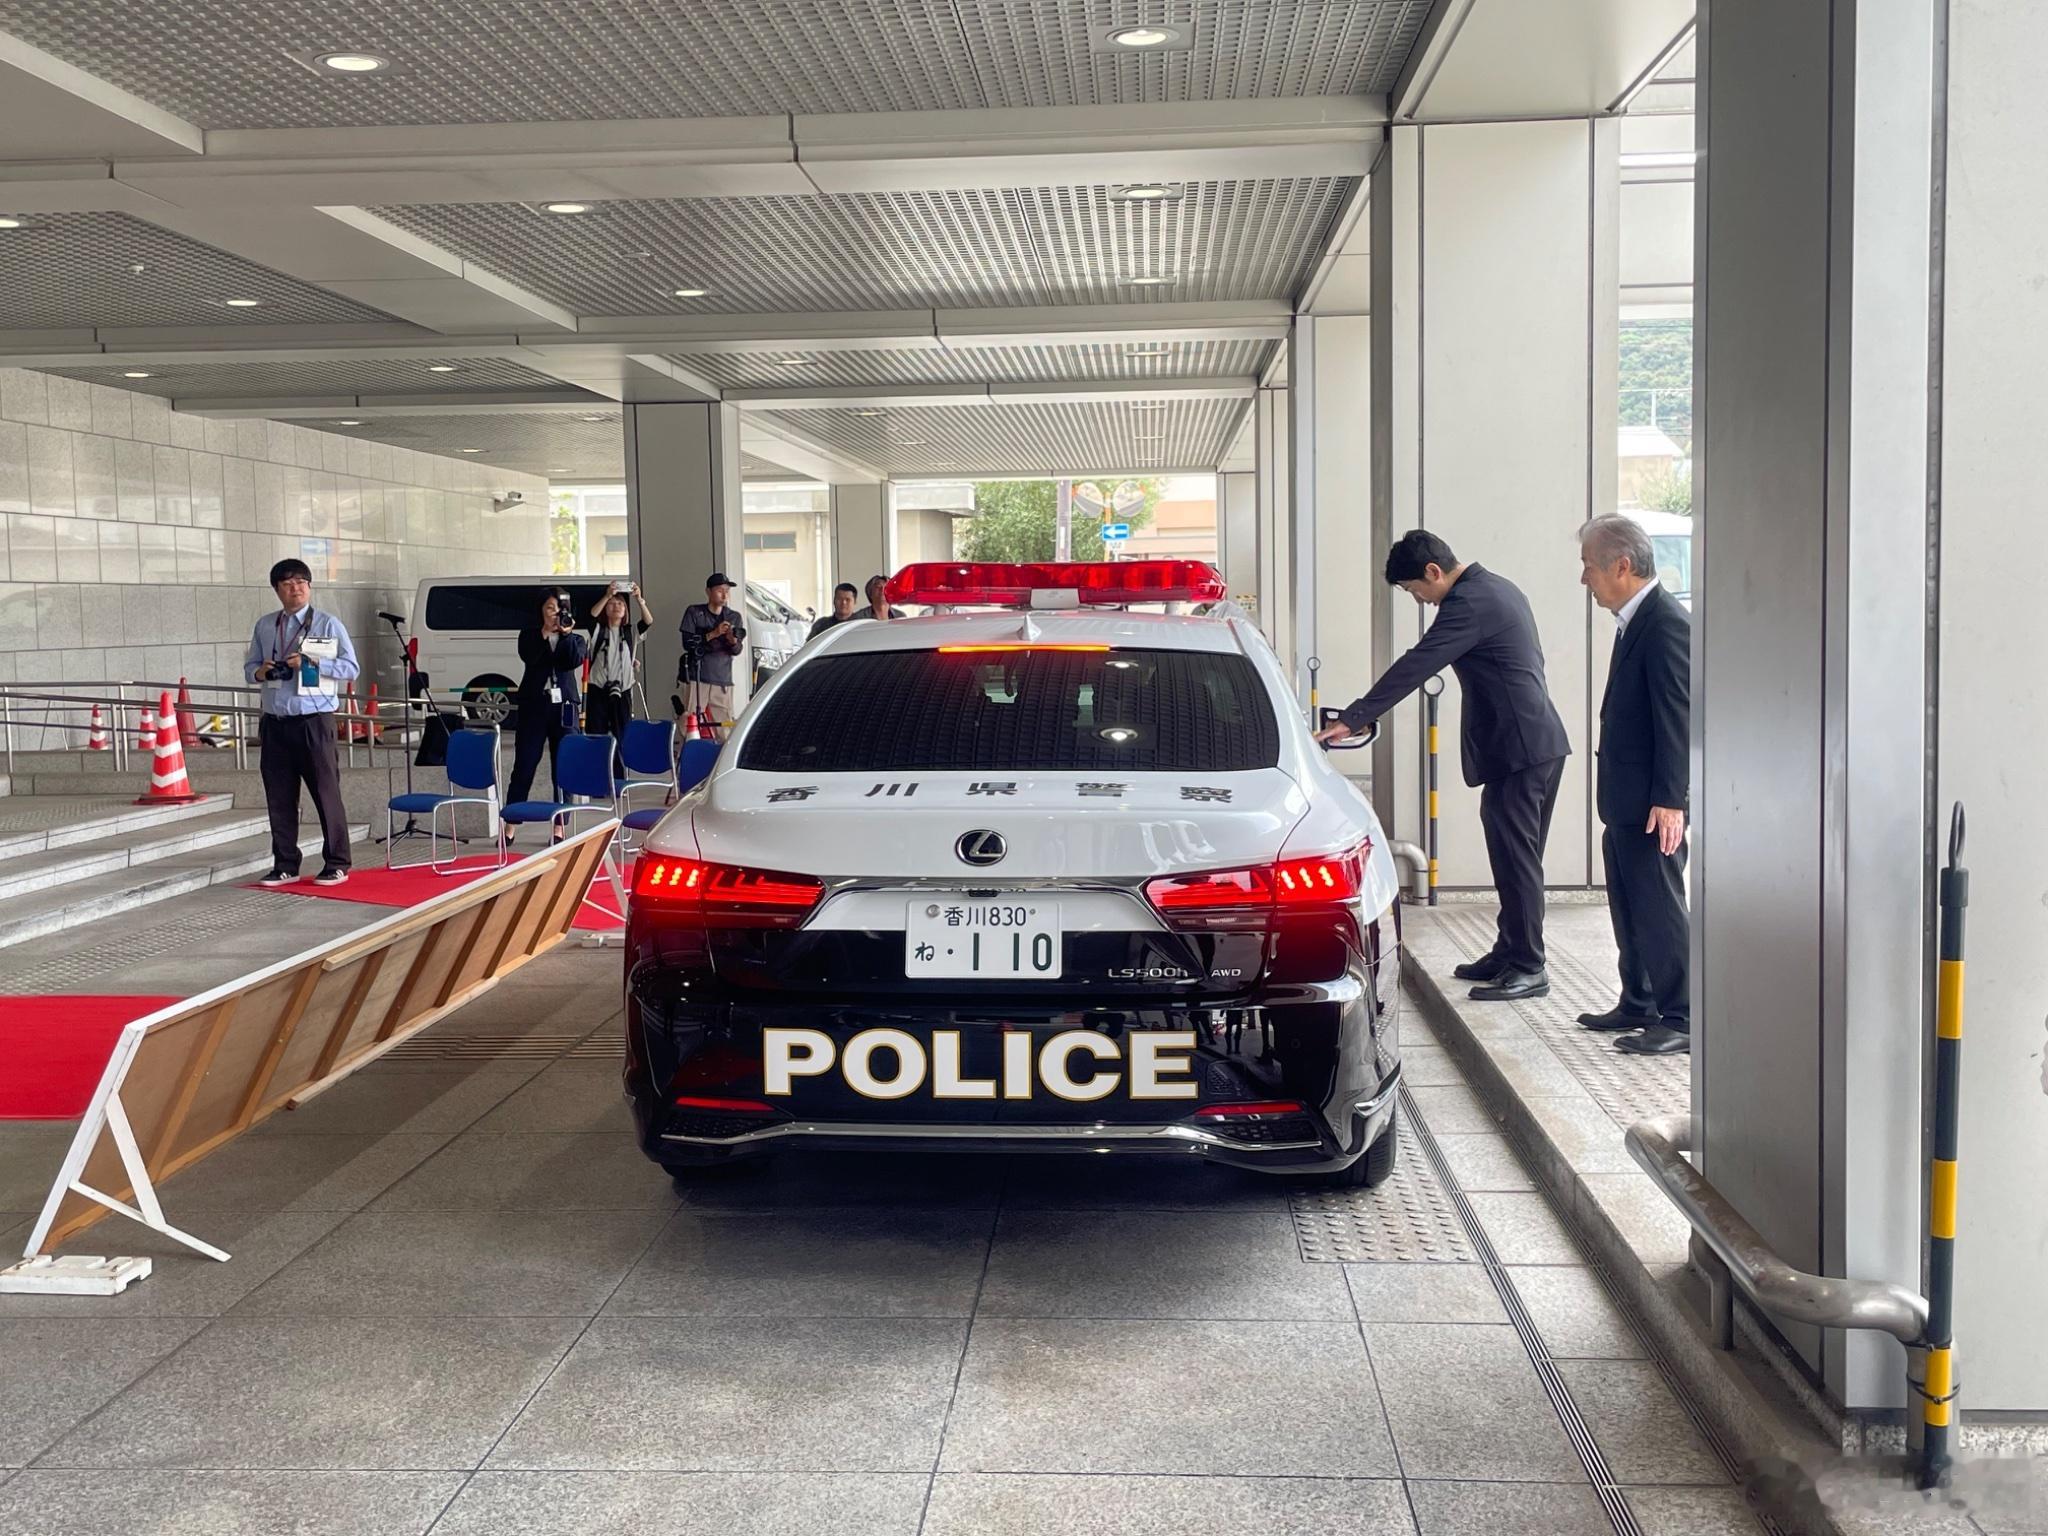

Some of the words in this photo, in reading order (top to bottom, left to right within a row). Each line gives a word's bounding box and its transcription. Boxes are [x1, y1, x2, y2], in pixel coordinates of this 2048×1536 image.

[766, 782, 1232, 803] 香川県警察
[944, 906, 1027, 927] 香川830
[1107, 967, 1189, 978] LS500h
[1211, 968, 1242, 977] AWD
[763, 1027, 1199, 1101] POLICE
